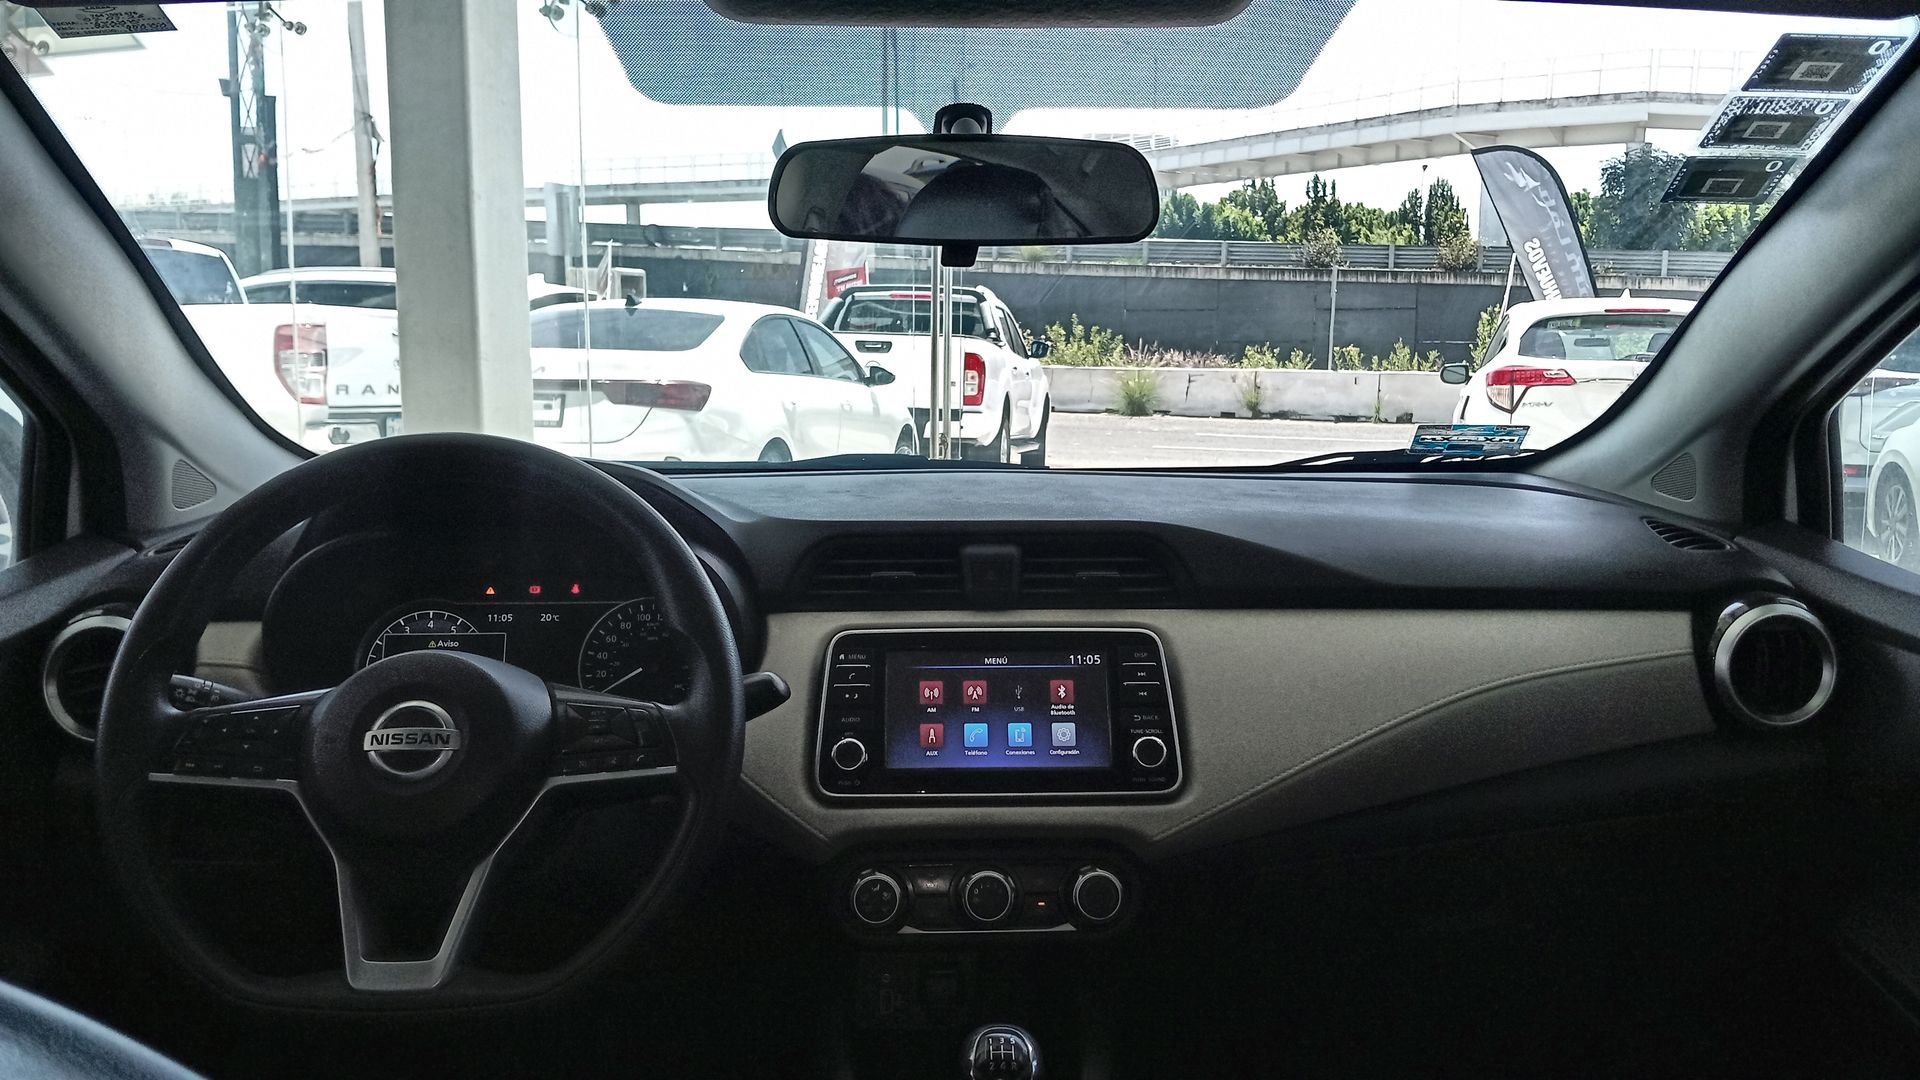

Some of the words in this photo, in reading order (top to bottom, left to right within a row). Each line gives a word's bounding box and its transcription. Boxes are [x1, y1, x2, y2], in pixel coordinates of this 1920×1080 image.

[336, 384, 400, 395] RAN
[487, 614, 514, 622] 11:05
[636, 613, 651, 622] 100
[427, 620, 434, 629] 4
[620, 622, 632, 630] 80
[403, 626, 410, 634] 3
[450, 626, 457, 634] 5
[605, 635, 617, 643] 60
[436, 640, 460, 648] Aviso
[596, 652, 608, 660] 40
[1069, 654, 1101, 666] 11:05
[595, 670, 607, 678] 20
[370, 732, 451, 747] NISSAN
[989, 1062, 995, 1071] 2
[1011, 1062, 1018, 1071] R
